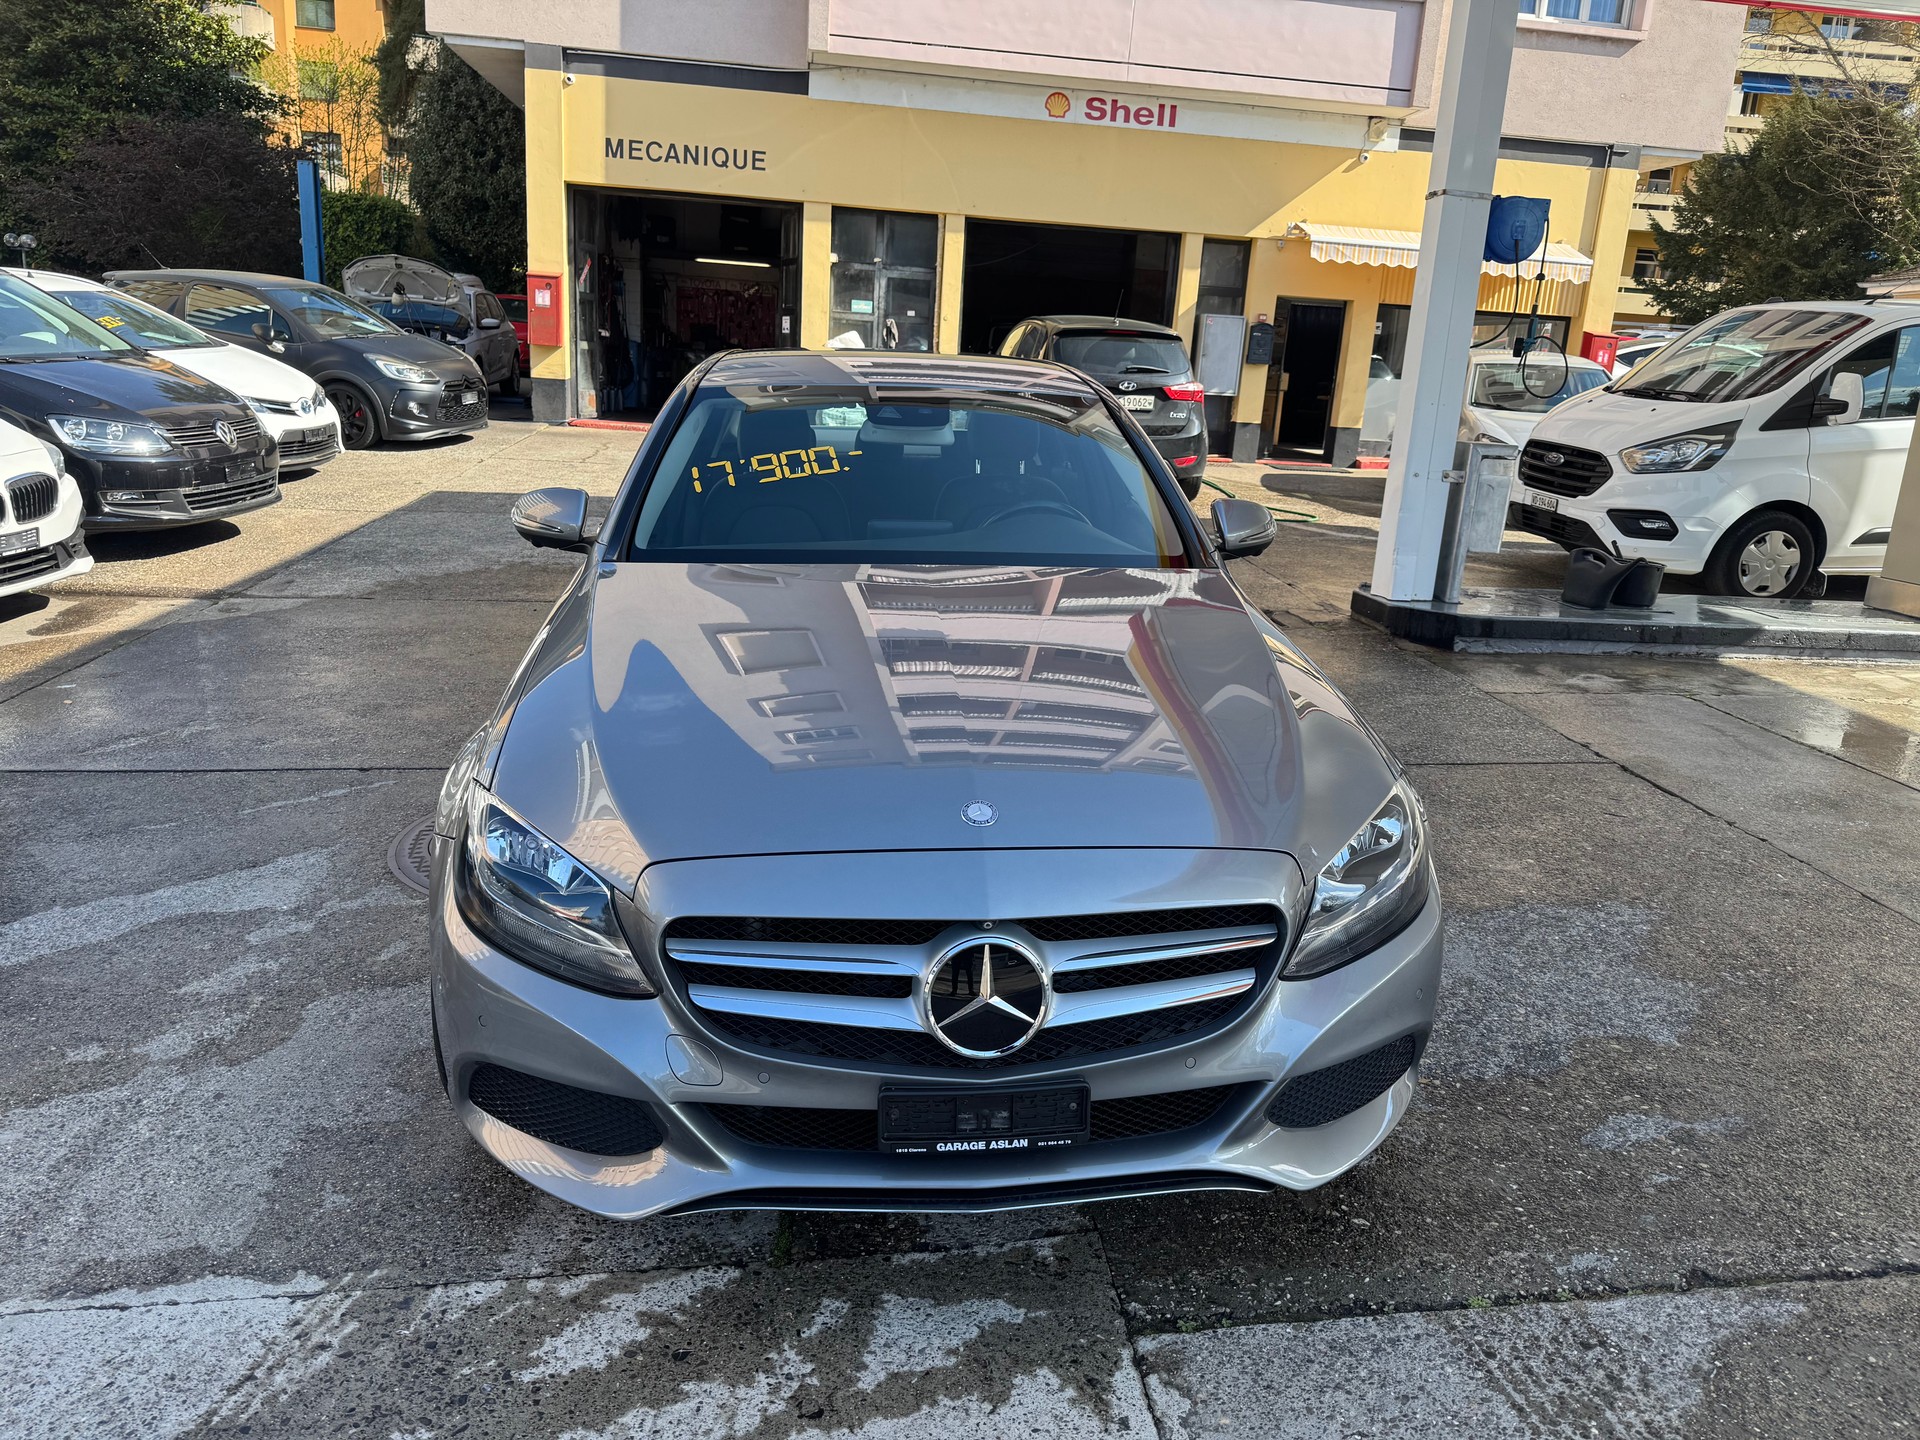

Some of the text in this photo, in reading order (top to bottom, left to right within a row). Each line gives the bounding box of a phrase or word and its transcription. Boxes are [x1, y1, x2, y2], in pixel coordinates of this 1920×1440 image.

[1084, 96, 1178, 128] Shell
[605, 137, 767, 171] MECANIQUE
[936, 1141, 986, 1152] GARAGE
[989, 1138, 1029, 1150] ASLAN
